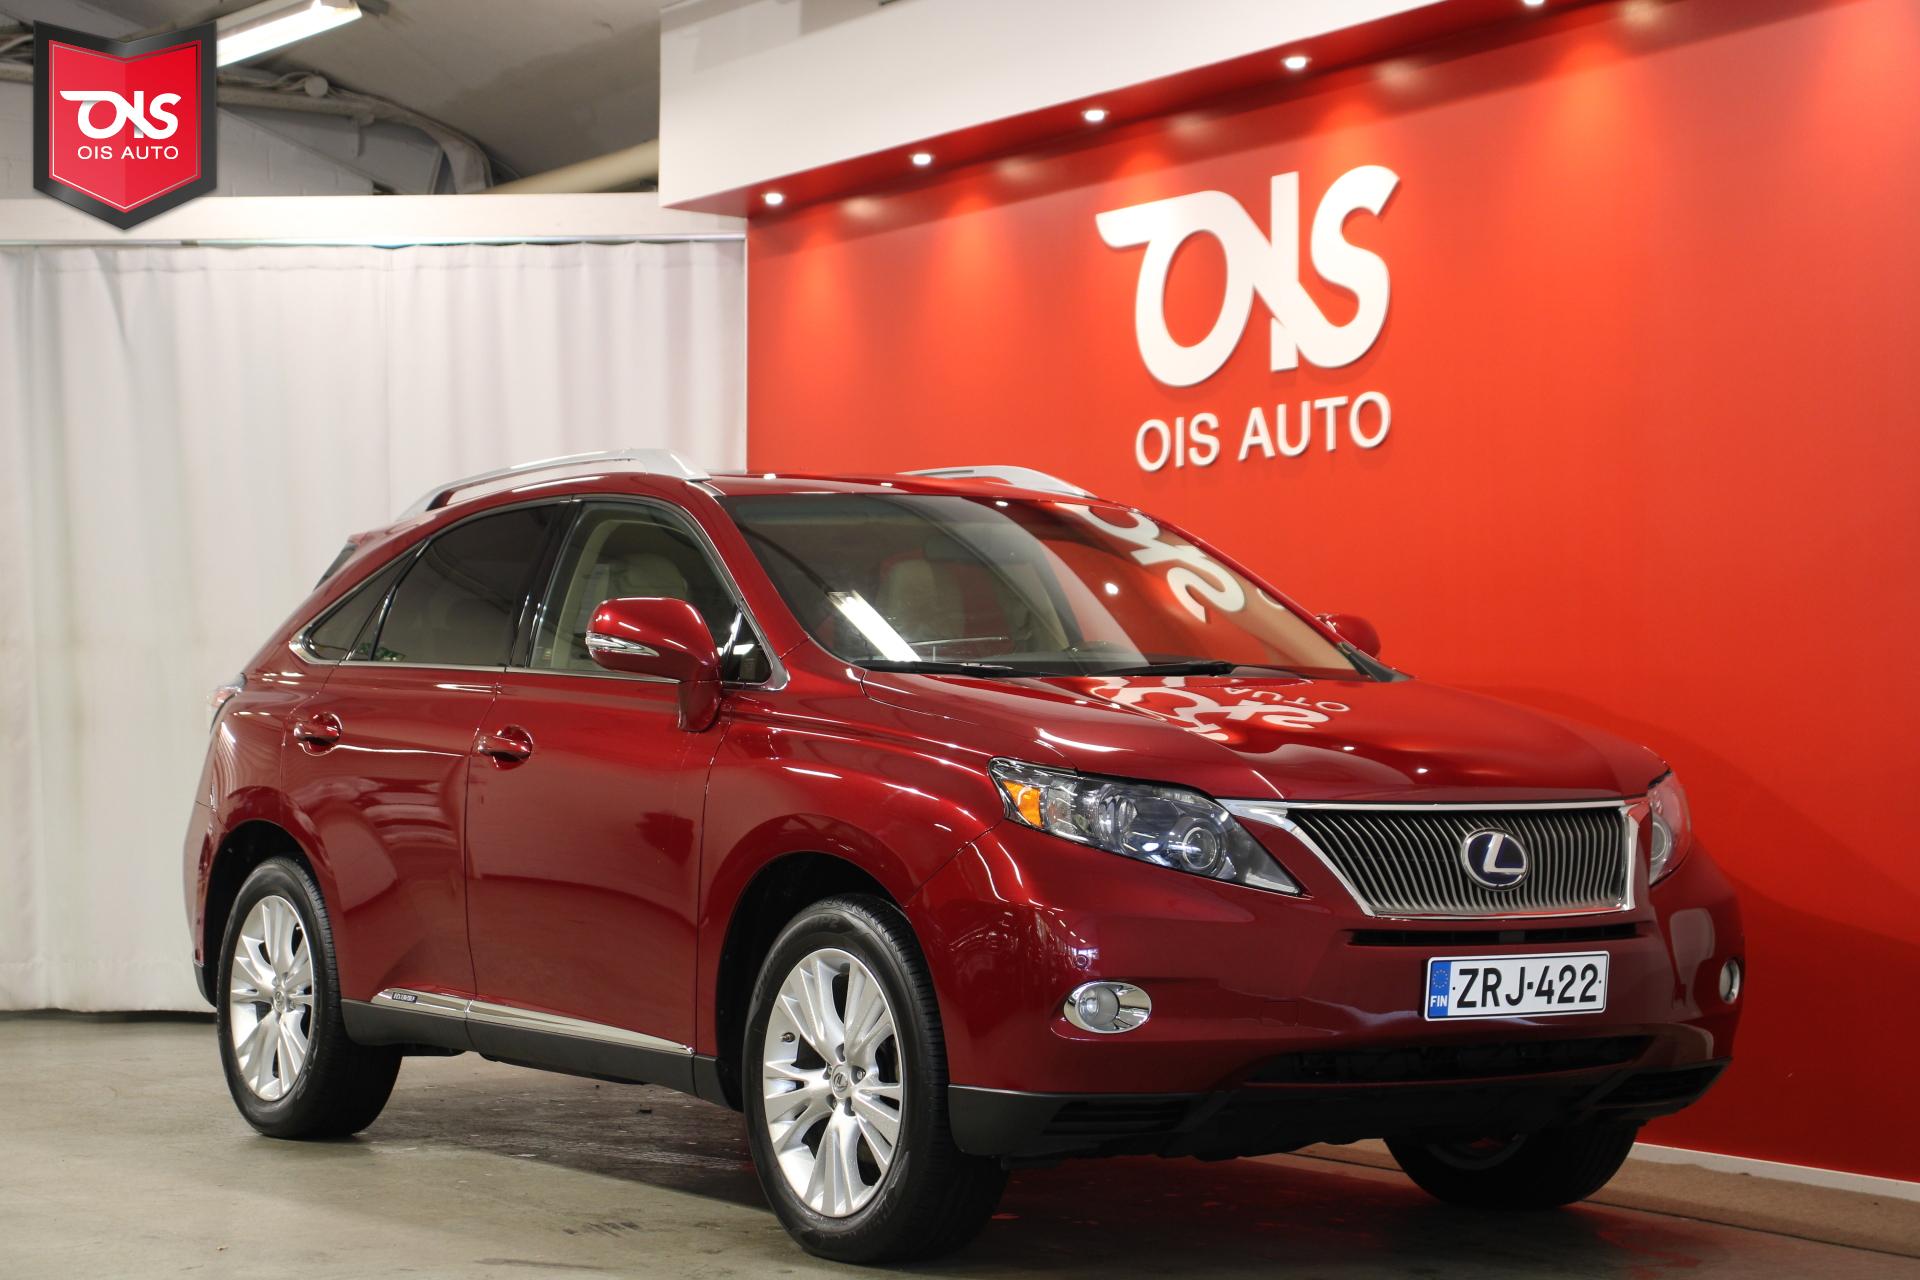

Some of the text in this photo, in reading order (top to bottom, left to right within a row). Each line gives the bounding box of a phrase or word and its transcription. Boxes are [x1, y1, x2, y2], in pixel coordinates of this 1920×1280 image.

[1135, 391, 1391, 472] OIS AUTO
[1430, 995, 1448, 1008] FIN
[1456, 963, 1599, 1008] ZRJ-422
